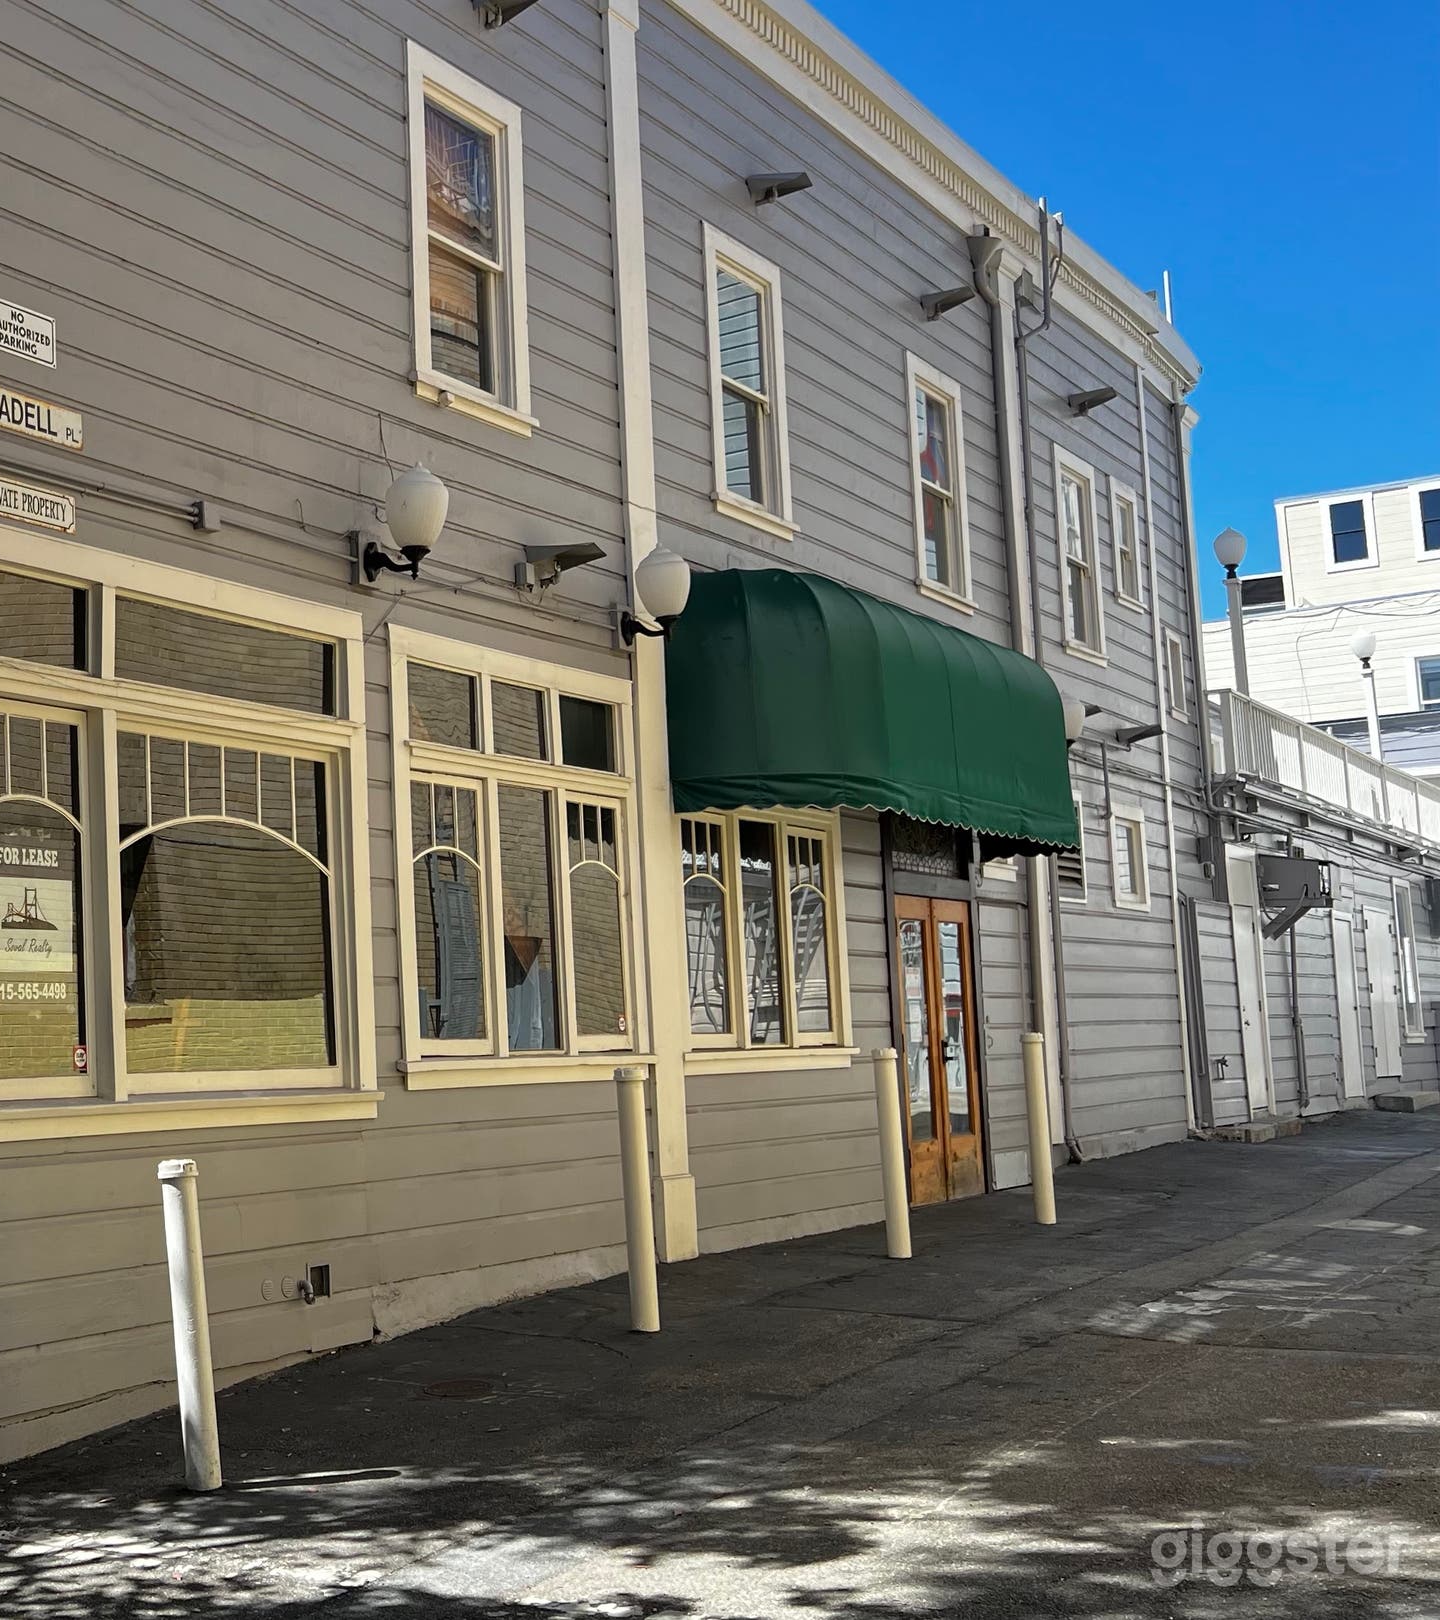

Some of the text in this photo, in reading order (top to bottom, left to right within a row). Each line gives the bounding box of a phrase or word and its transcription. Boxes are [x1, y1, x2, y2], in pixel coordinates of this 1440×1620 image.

[11, 310, 24, 323] NO
[0, 333, 37, 355] PARKING
[22, 494, 66, 521] PROPERTY
[22, 848, 58, 867] LEASE
[29, 938, 51, 958] Realty
